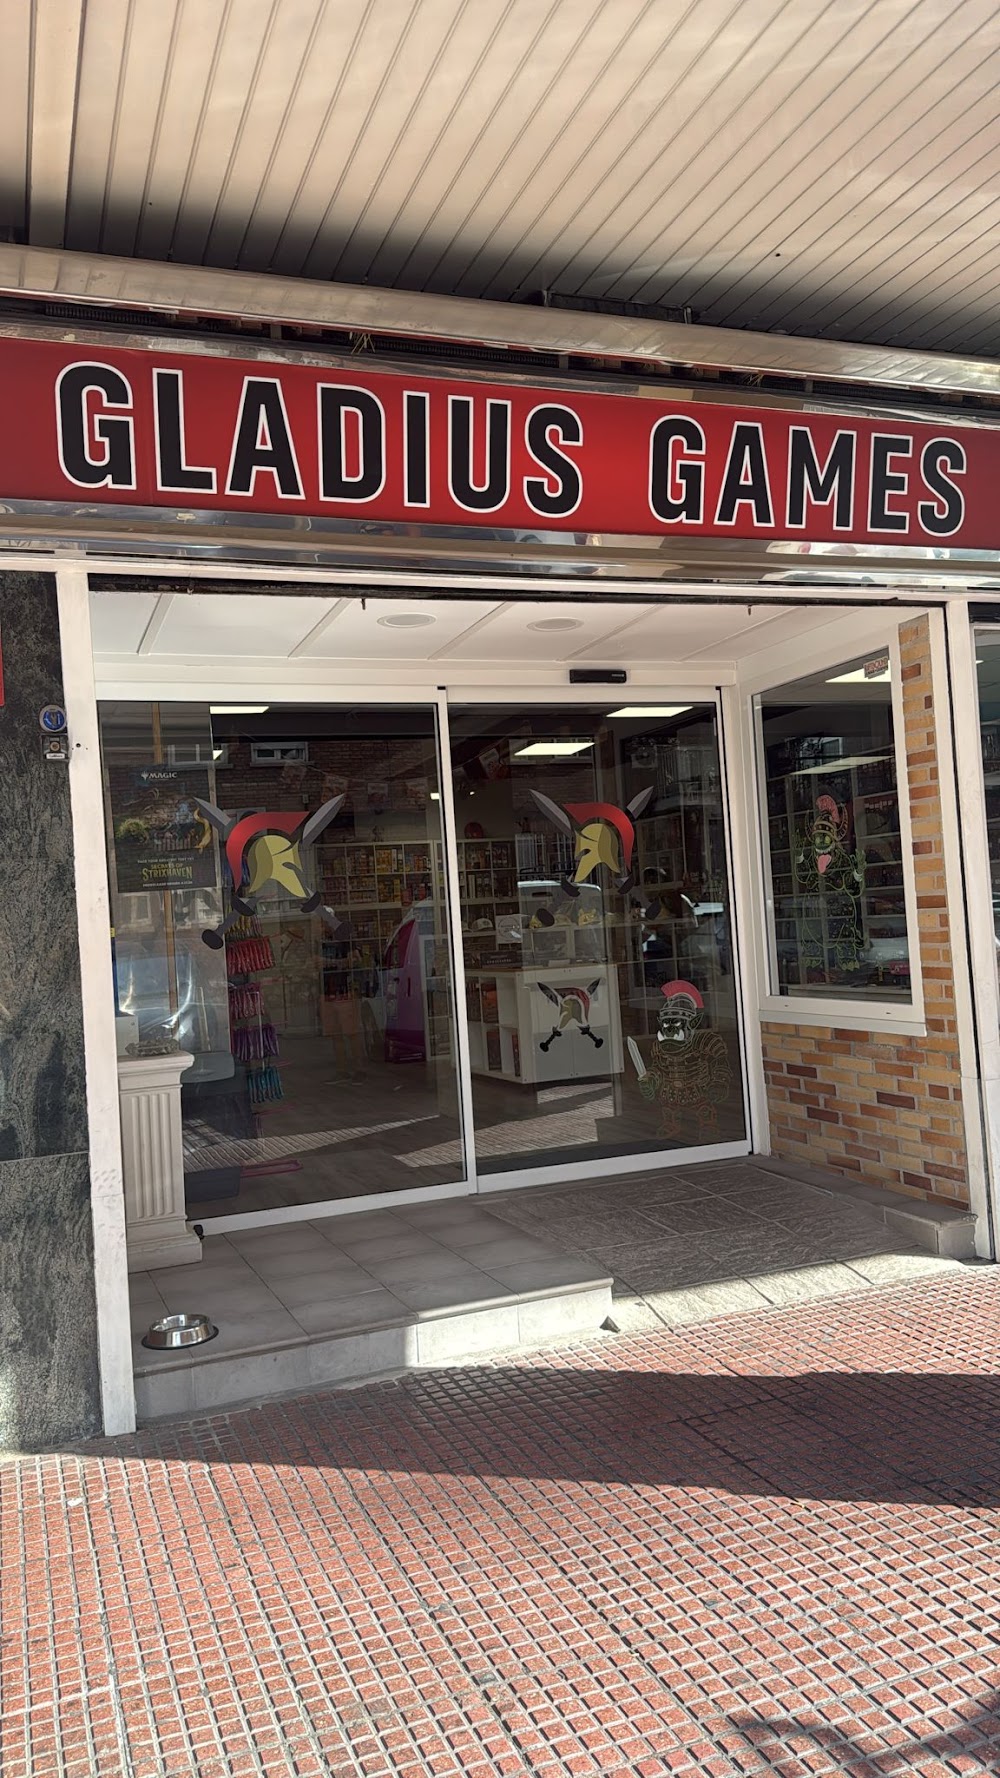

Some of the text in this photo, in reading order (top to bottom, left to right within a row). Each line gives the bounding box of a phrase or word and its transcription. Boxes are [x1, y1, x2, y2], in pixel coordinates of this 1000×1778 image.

[55, 361, 967, 537] GLADIUS GAMES
[143, 866, 192, 881] STRIXHAVEN
